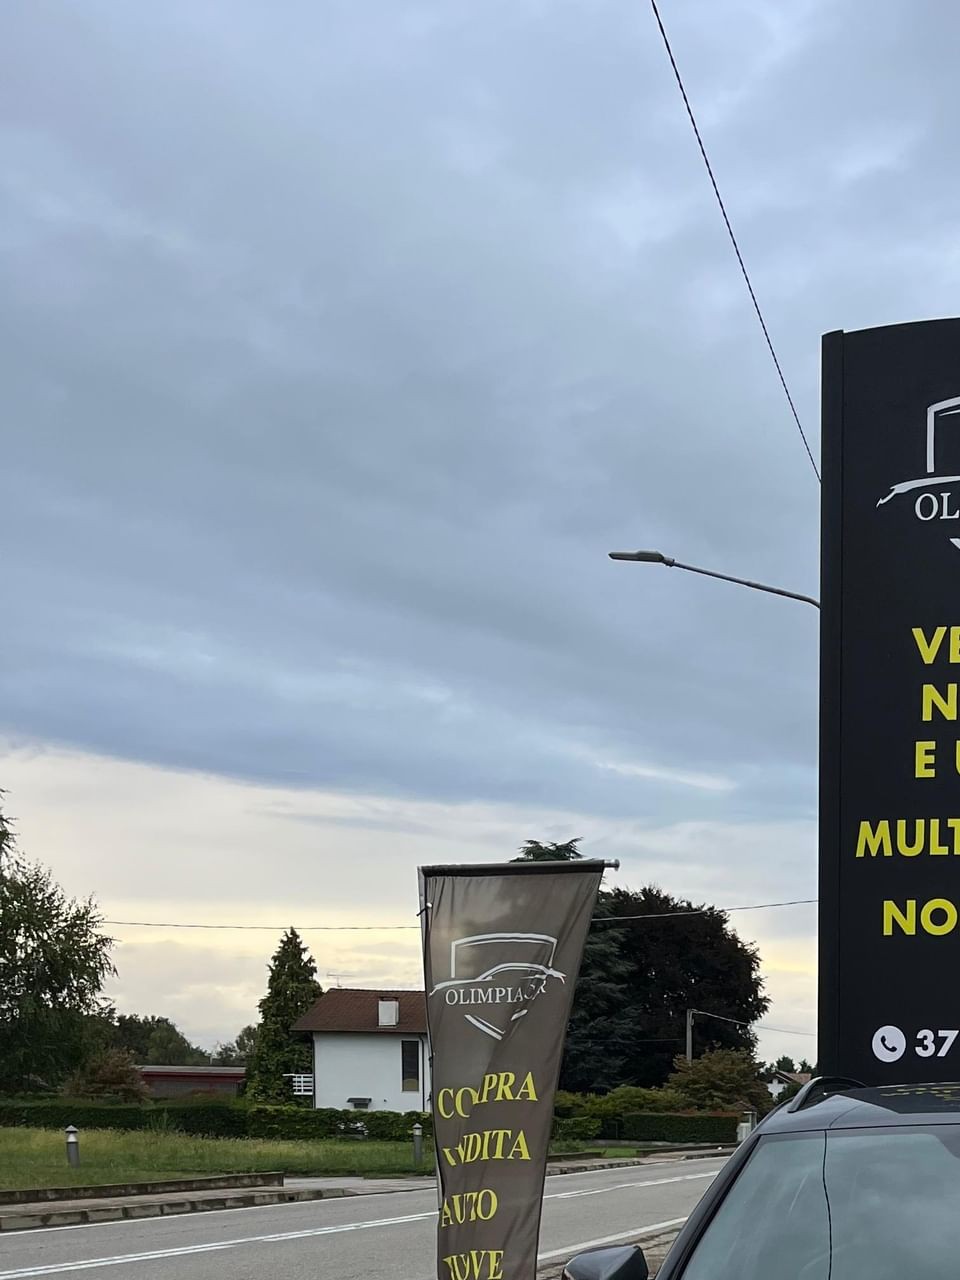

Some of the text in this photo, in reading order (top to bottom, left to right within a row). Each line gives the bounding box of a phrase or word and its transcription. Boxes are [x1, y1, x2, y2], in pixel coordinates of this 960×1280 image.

[915, 741, 936, 778] E
[445, 986, 523, 1005] OLIMPIA
[438, 1071, 538, 1118] COPRA
[441, 1189, 498, 1227] AUTO
